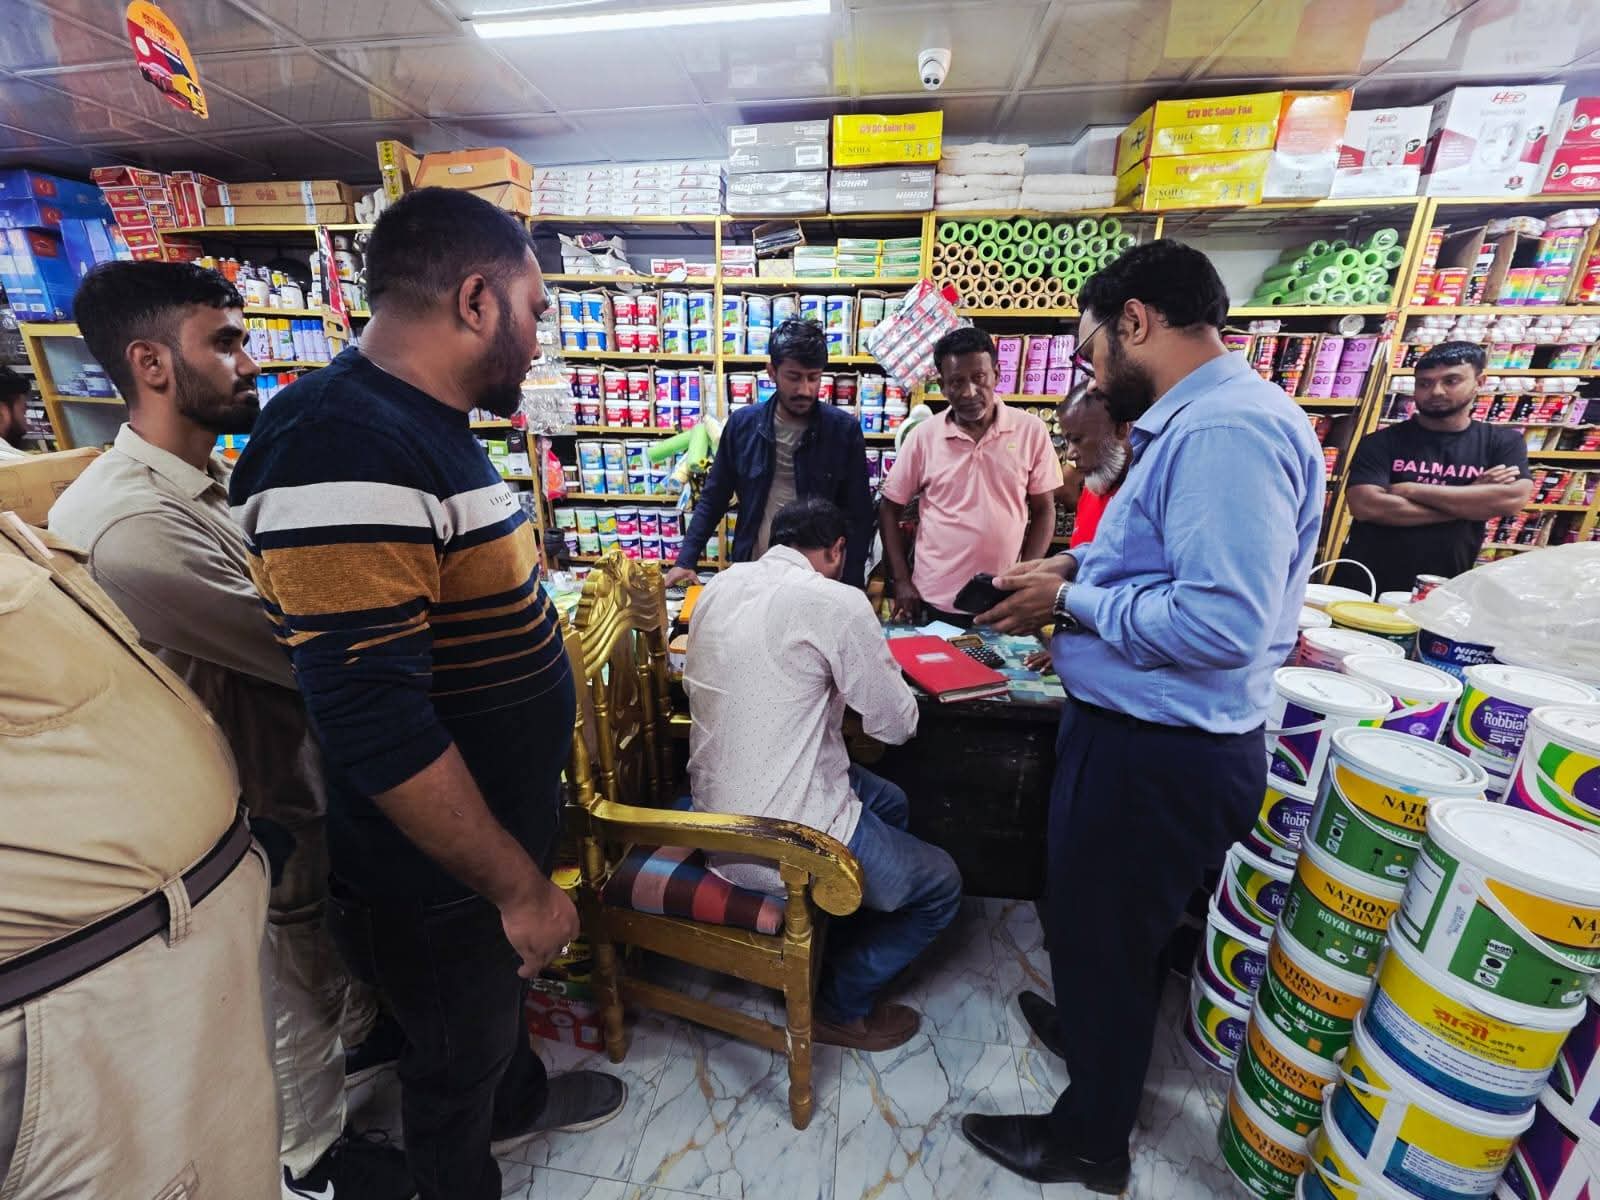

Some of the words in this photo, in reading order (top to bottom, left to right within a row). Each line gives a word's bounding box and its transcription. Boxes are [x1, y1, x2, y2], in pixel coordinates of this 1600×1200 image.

[1392, 459, 1485, 479] BALMAIN
[1380, 827, 1413, 841] OYAL
[1317, 909, 1351, 935] ROYAL
[1340, 903, 1386, 926] PAINT
[1277, 951, 1342, 1006] NATIONAL
[1295, 1001, 1336, 1030] MATTE
[1254, 1062, 1280, 1094] ROYAL
[1270, 1061, 1305, 1089] PAINT
[1241, 1143, 1271, 1175] ROYAL
